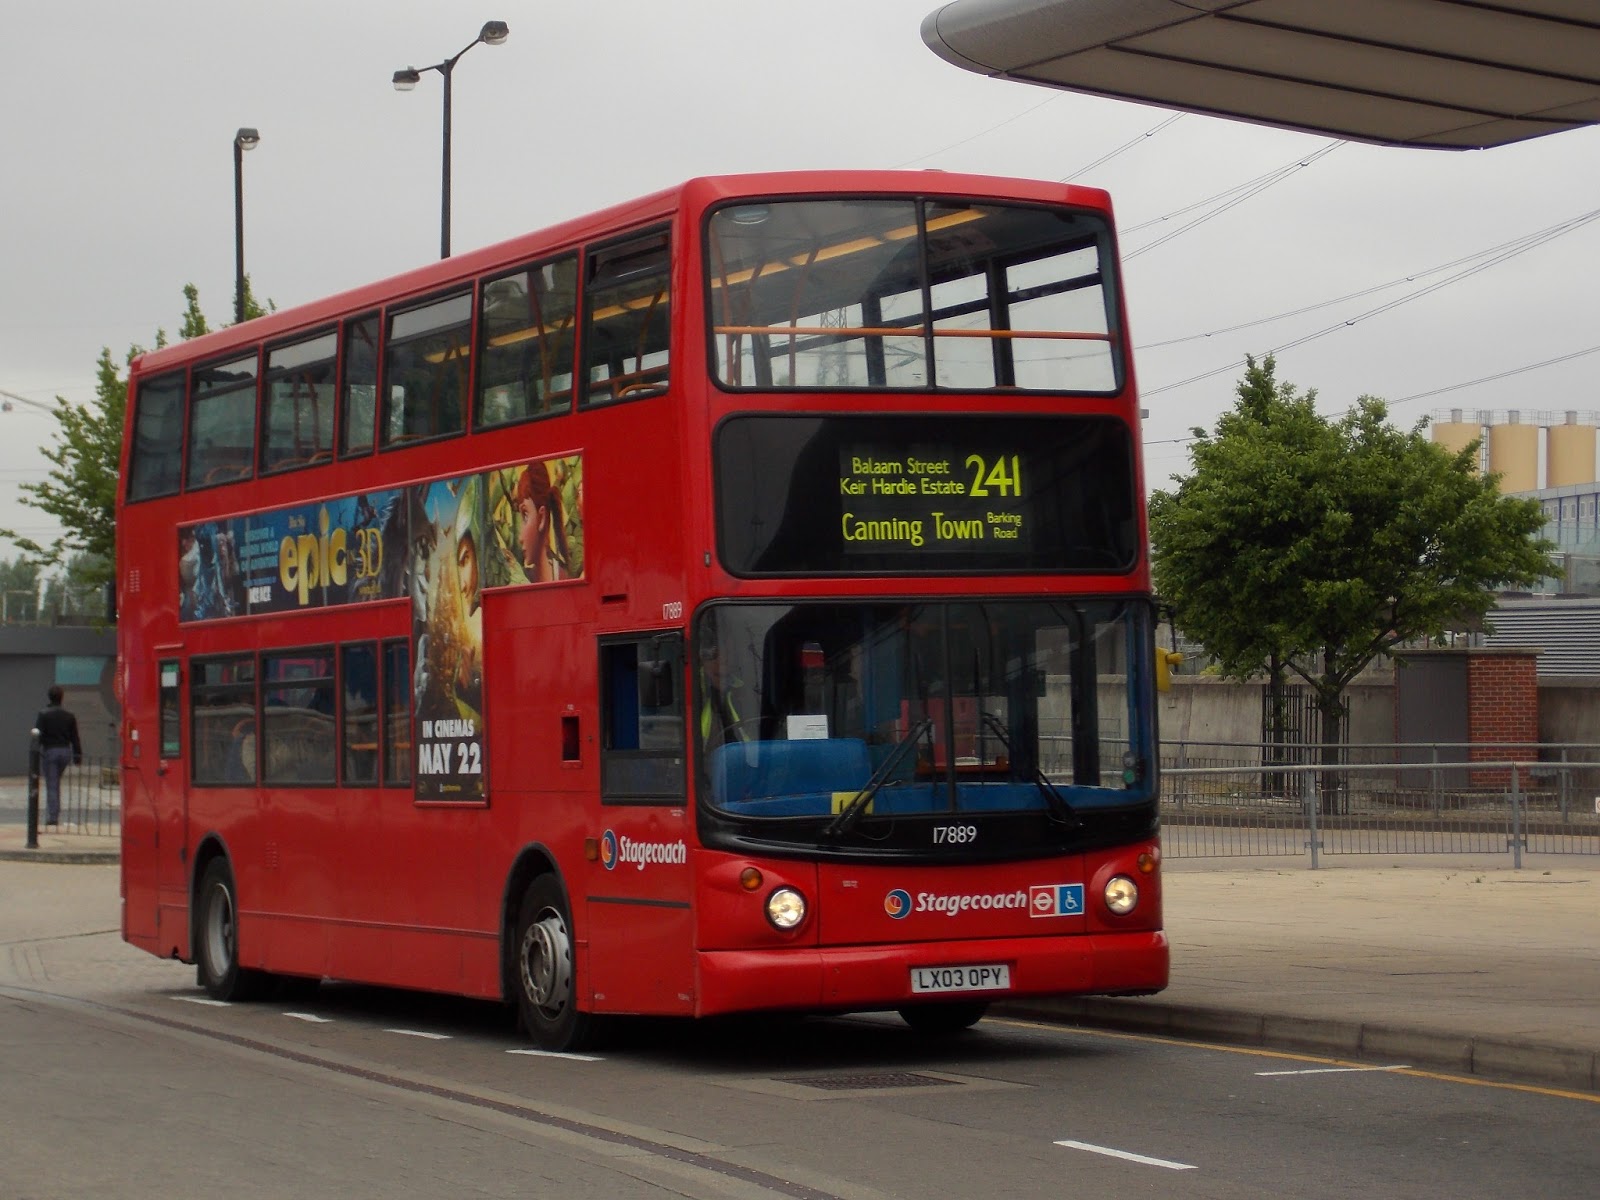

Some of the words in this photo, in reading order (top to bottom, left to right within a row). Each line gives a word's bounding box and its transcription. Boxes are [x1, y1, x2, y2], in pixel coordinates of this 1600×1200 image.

[852, 457, 902, 474] Balaam
[907, 457, 950, 474] Street
[965, 454, 1022, 497] 241
[840, 478, 867, 495] Keir
[872, 478, 917, 495] Hardie
[920, 478, 965, 495] Estate
[987, 512, 1022, 526] Barking
[842, 513, 924, 546] Canning
[931, 513, 984, 540] Town
[994, 527, 1018, 539] Road
[279, 503, 347, 606] epic
[355, 528, 383, 578] 3D
[662, 601, 683, 620] 17889
[422, 720, 433, 738] IN
[434, 719, 475, 738] CINEMAS
[418, 743, 452, 774] MAY
[457, 742, 482, 774] 22
[933, 826, 977, 844] 17889
[619, 836, 686, 871] Stagecoach
[915, 891, 1027, 916] Stagecoach
[919, 969, 964, 989] LX03
[968, 967, 1002, 986] OPY
